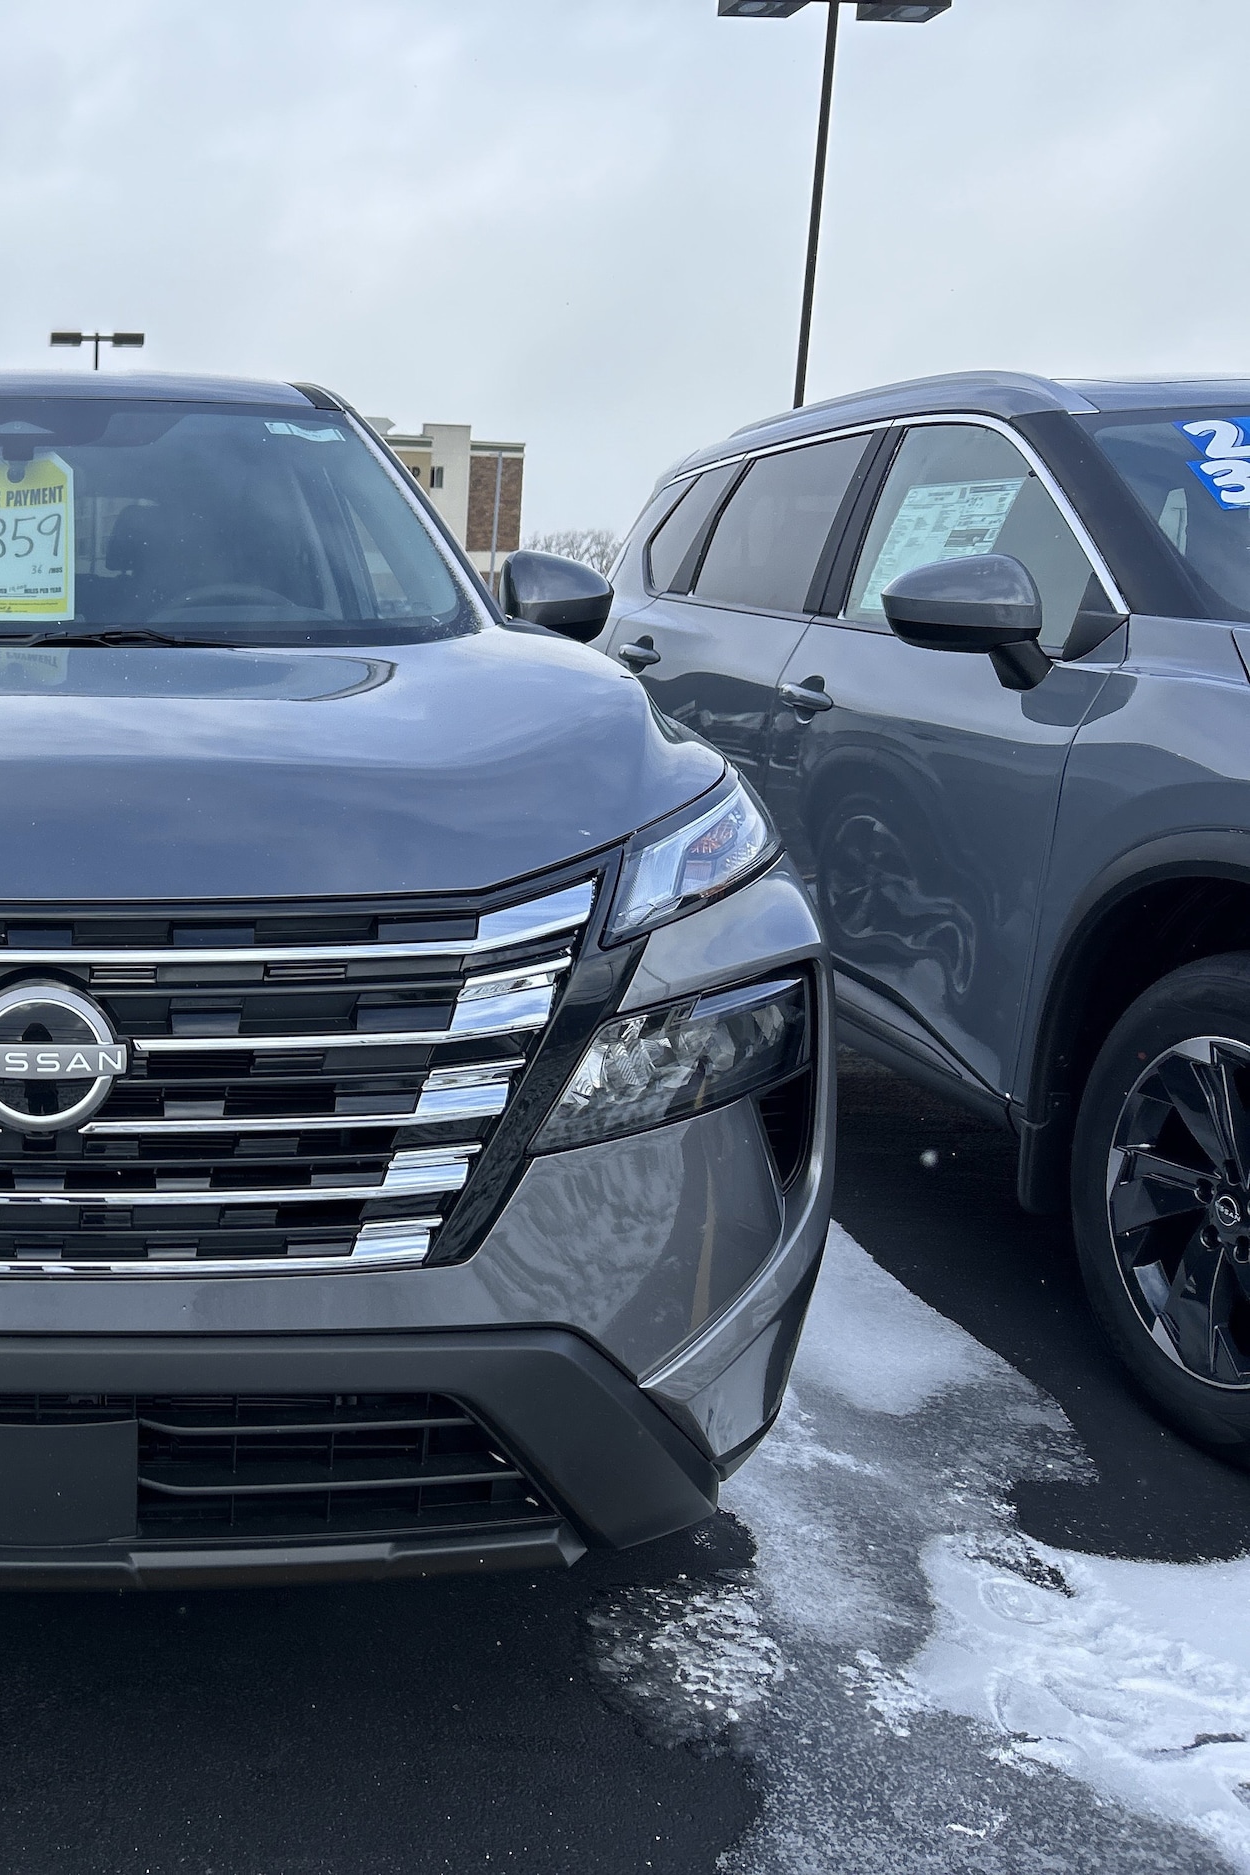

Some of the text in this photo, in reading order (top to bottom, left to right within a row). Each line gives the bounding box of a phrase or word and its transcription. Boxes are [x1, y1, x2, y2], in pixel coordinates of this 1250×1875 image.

[1182, 419, 1250, 459] 2
[5, 485, 64, 507] PAYMENT
[31, 564, 44, 575] 36
